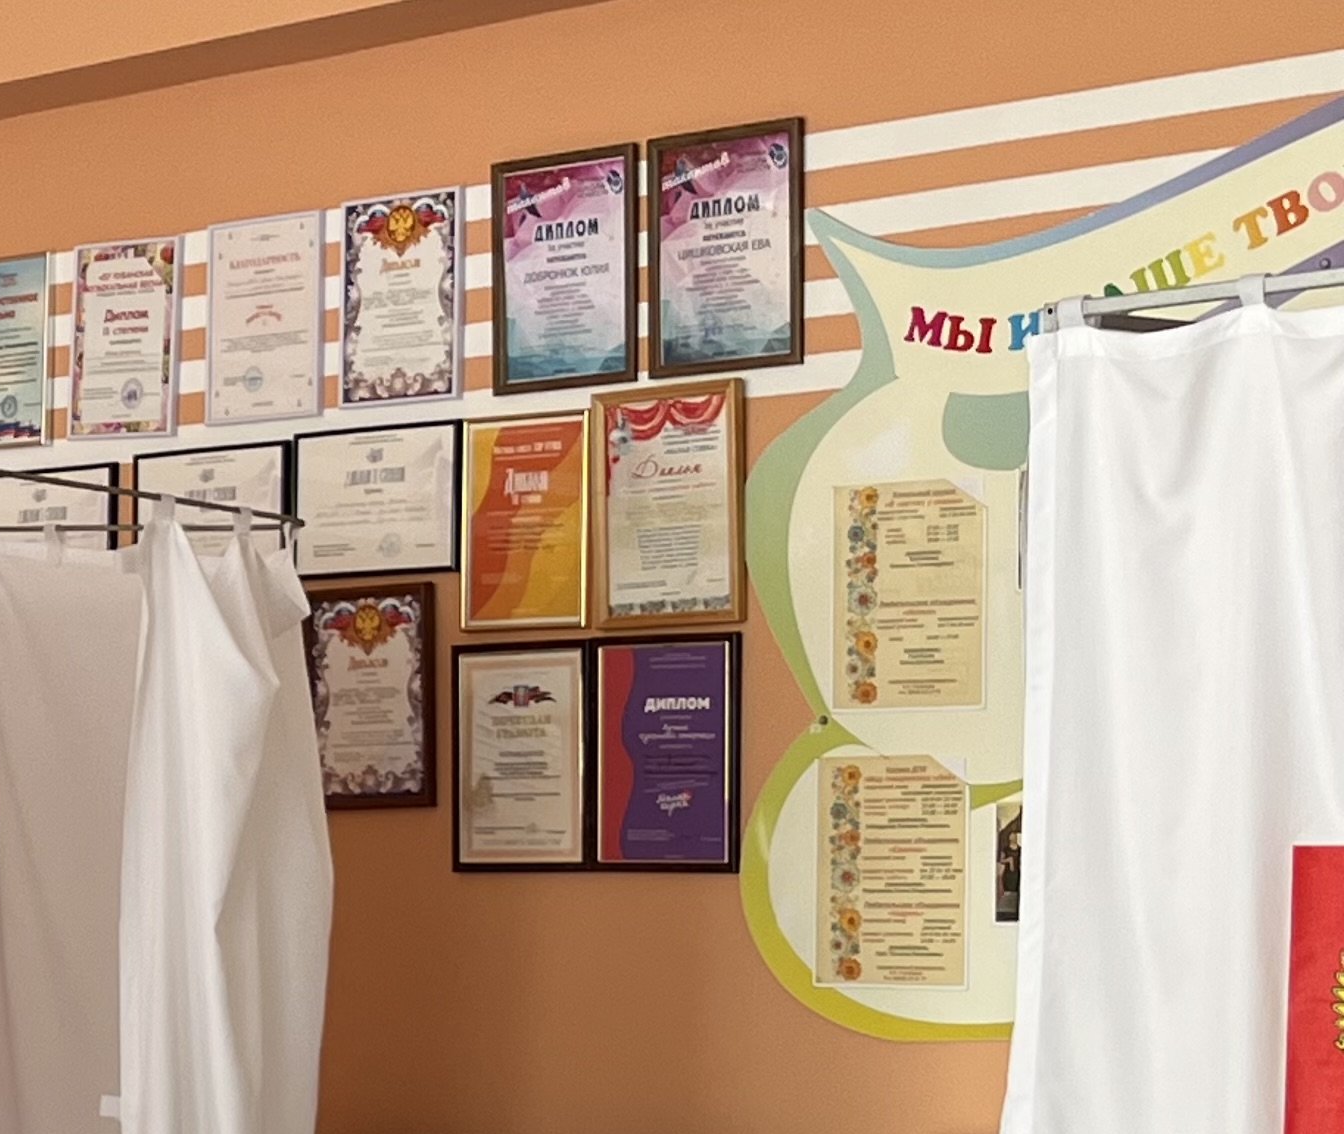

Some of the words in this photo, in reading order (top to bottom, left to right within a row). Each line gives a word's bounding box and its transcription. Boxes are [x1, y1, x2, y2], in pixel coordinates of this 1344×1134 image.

[690, 194, 760, 220] ДИПЛОМ
[534, 217, 599, 242] ДИПЛОМ
[904, 306, 997, 354] МЫ
[1233, 166, 1344, 251] ТВО
[643, 696, 711, 713] ДИПЛОМ
